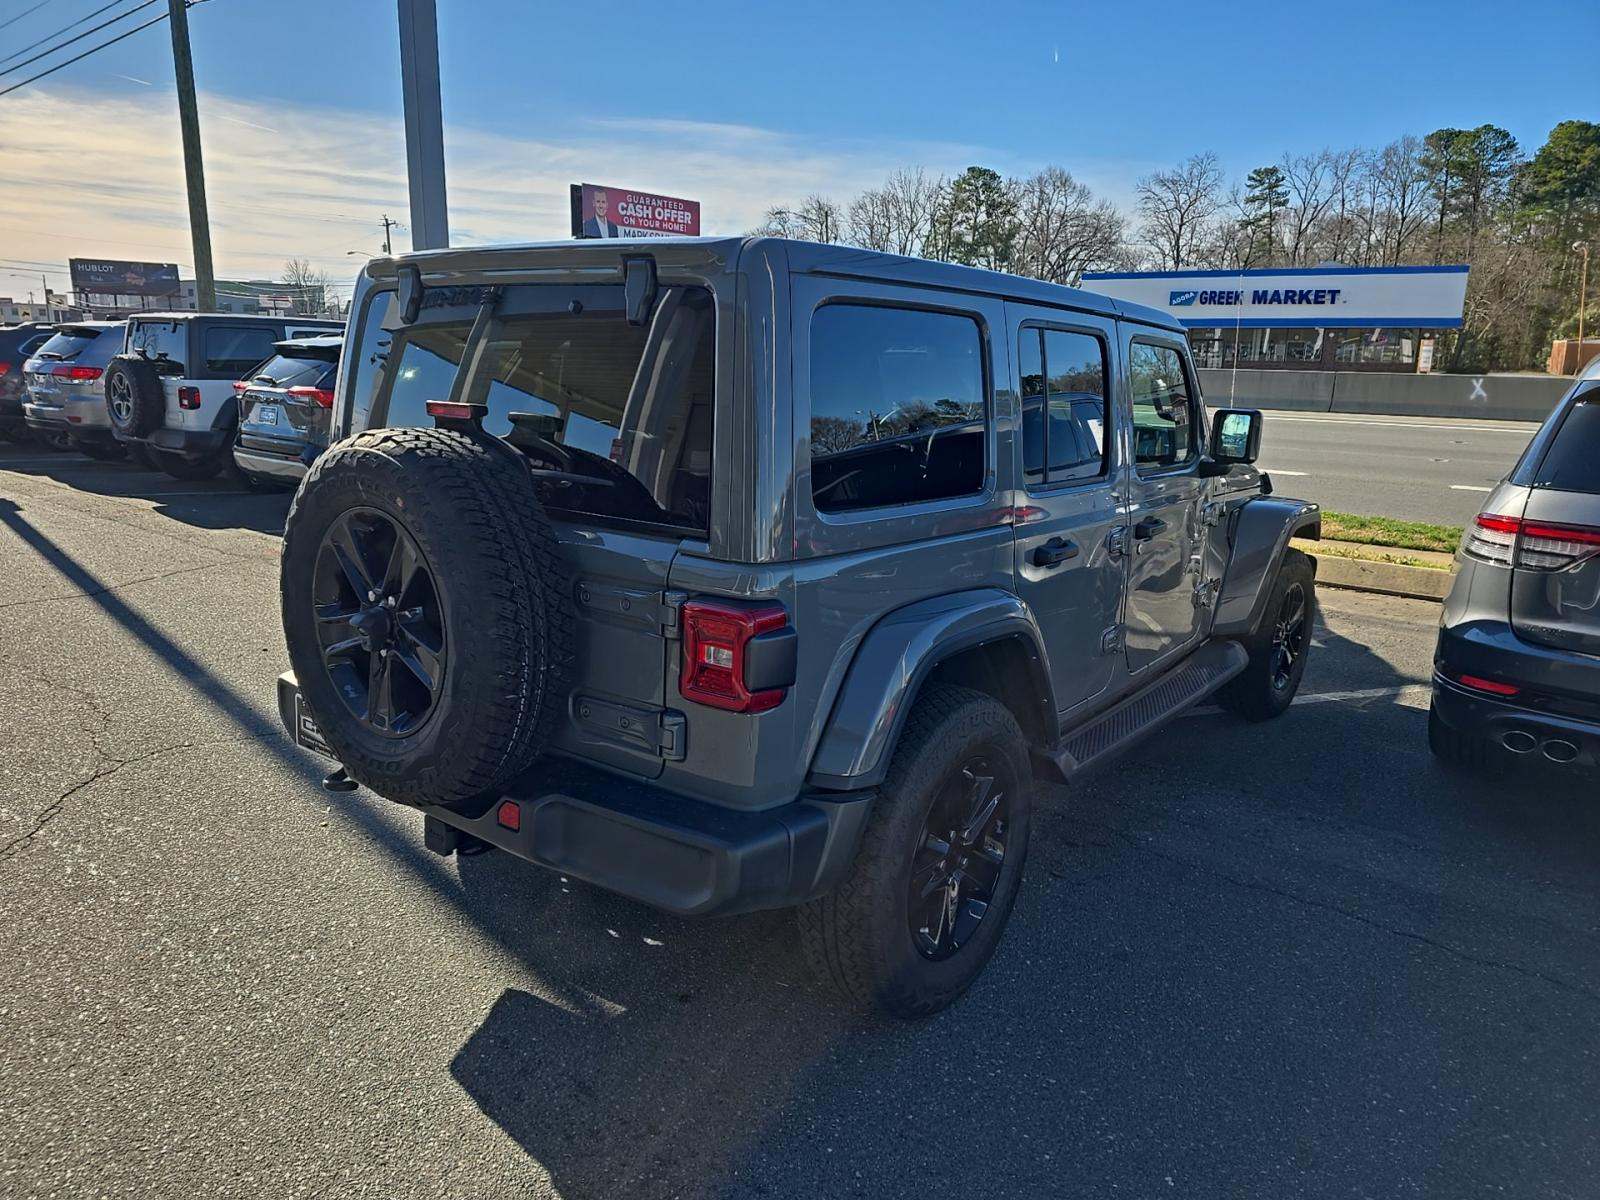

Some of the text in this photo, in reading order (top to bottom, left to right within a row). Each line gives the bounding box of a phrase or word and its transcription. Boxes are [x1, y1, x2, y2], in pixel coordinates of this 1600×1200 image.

[626, 194, 684, 210] GUARANTEED
[618, 202, 692, 225] CASH OFFER
[623, 216, 687, 232] ON YOUR HOME!
[77, 264, 114, 272] HUBLOT
[1200, 290, 1244, 305] GREEK
[1252, 290, 1341, 305] MARKET
